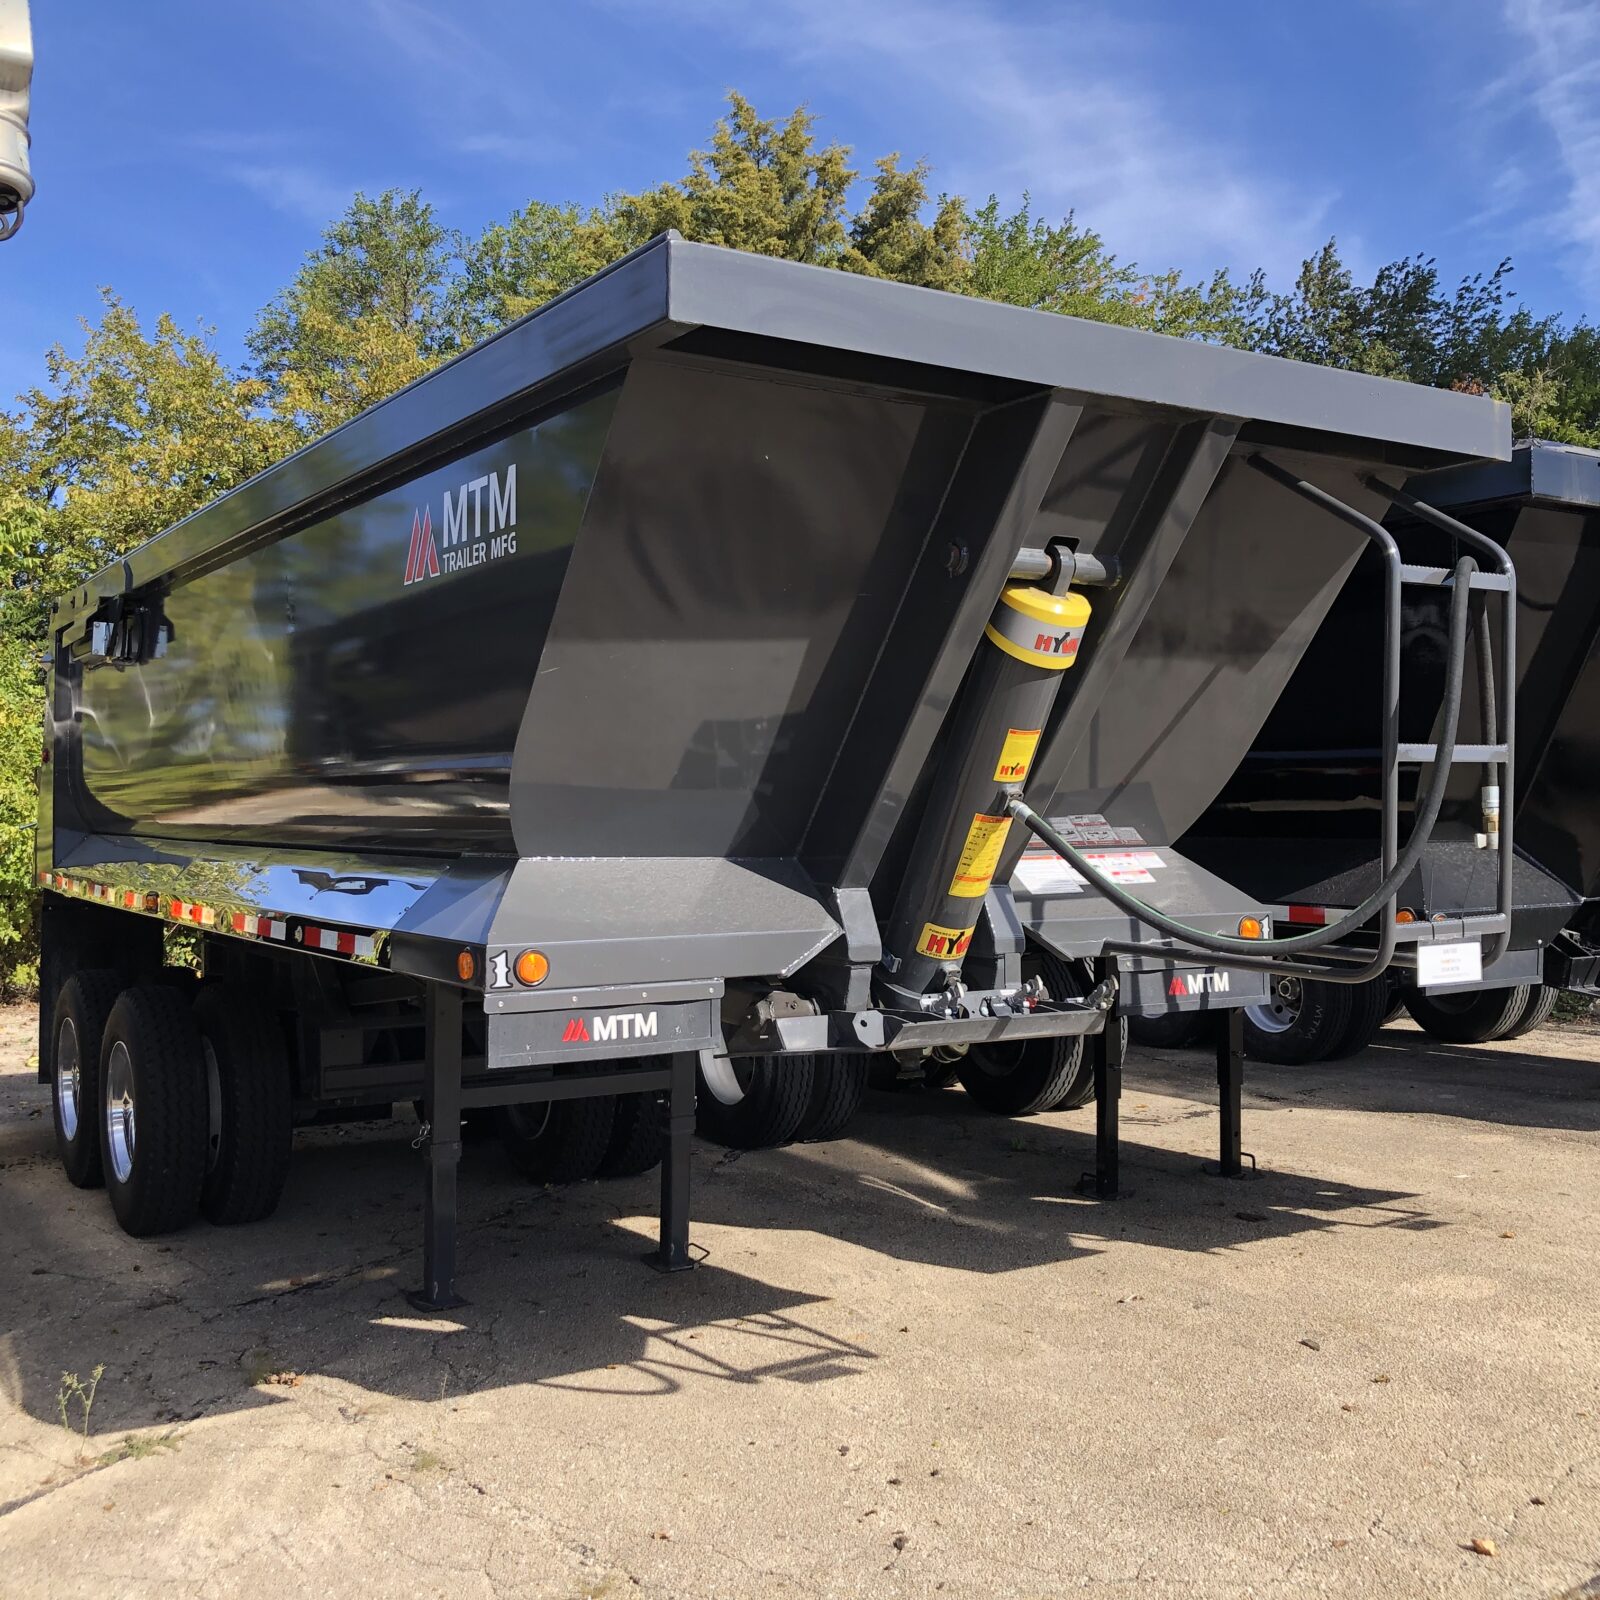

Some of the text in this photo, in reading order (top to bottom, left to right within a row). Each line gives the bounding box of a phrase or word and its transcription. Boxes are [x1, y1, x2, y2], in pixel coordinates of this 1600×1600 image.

[443, 464, 517, 548] MTM
[443, 532, 517, 574] TRAILER MFG
[926, 931, 972, 955] HYV
[489, 950, 513, 989] 1
[1187, 972, 1230, 994] MTM
[593, 1011, 658, 1041] MTM
